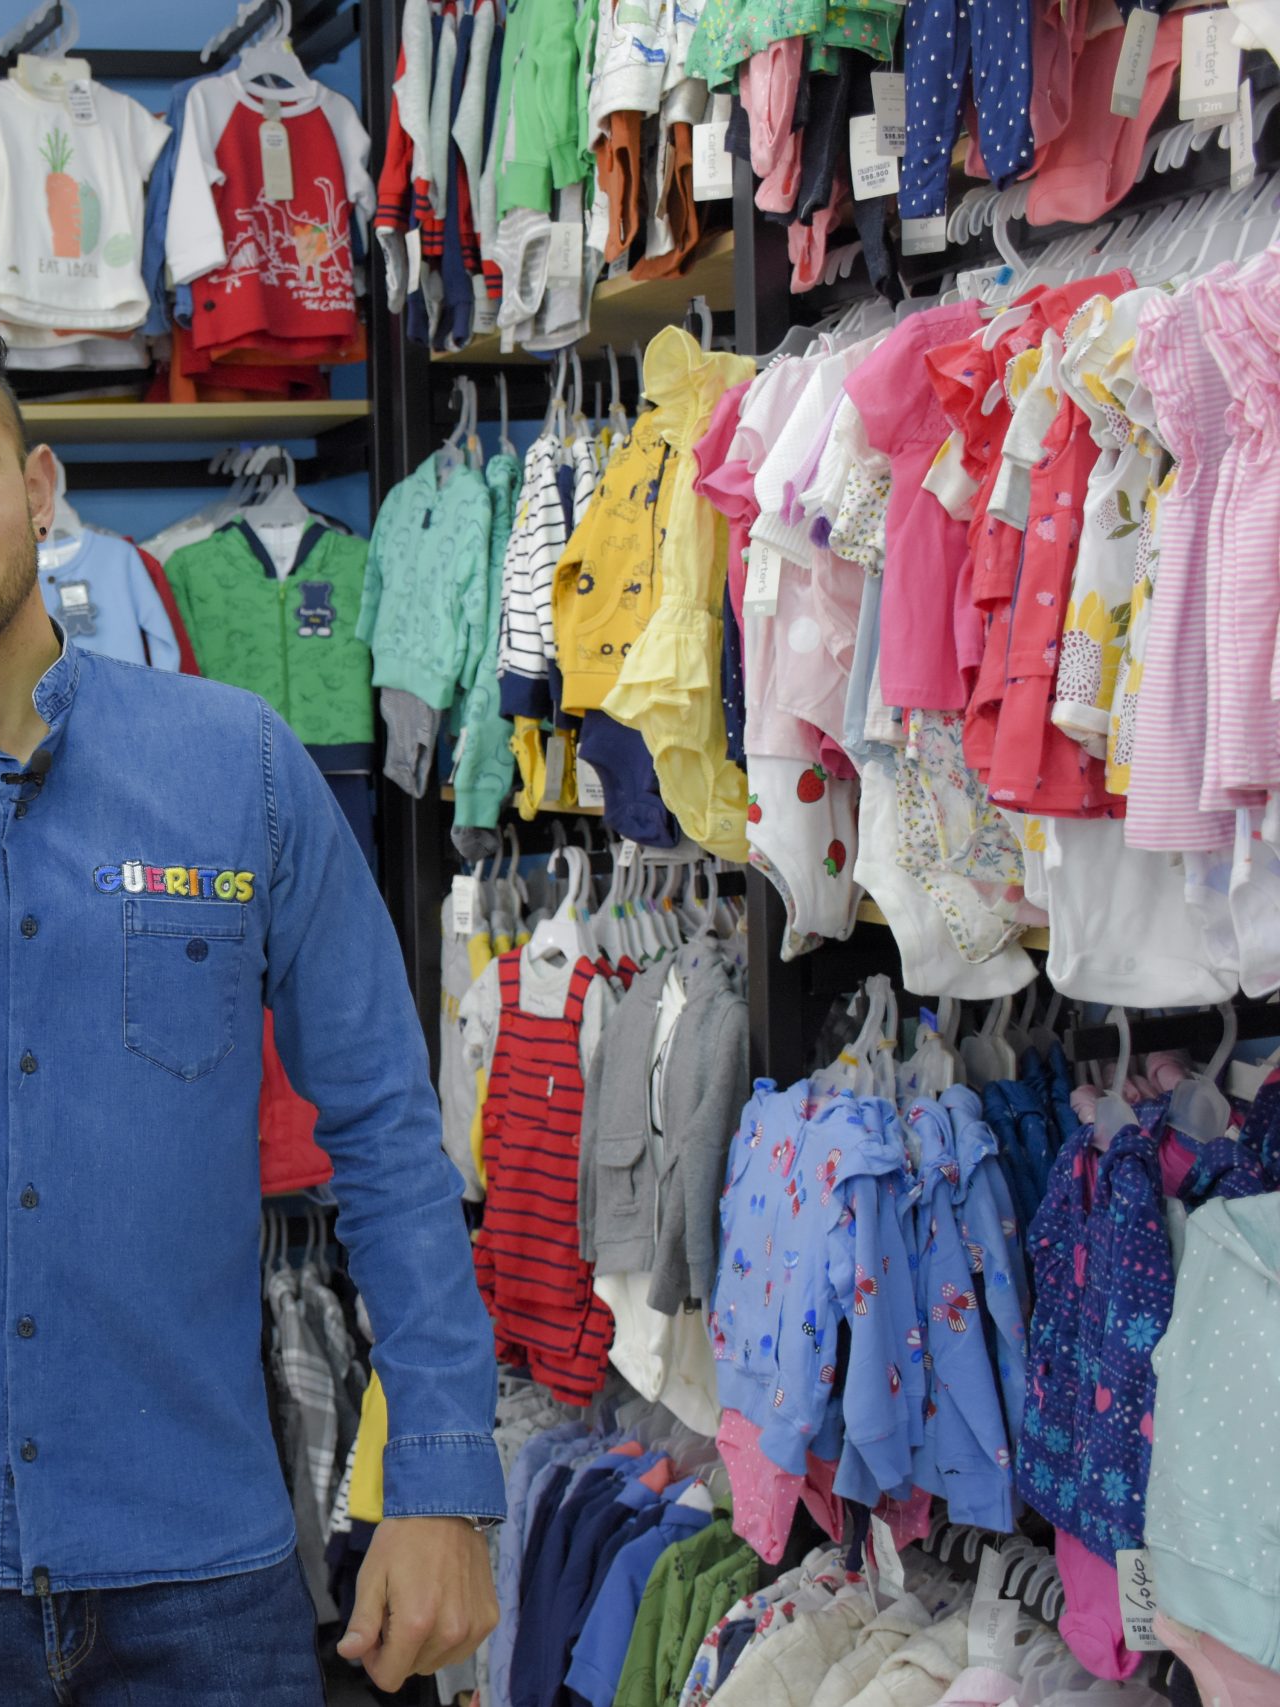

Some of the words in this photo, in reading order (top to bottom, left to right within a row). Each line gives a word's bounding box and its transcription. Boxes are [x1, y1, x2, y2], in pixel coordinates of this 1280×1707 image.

[1127, 25, 1146, 87] carter's
[1205, 25, 1219, 87] carter's
[1197, 102, 1222, 113] 12m
[38, 257, 60, 275] EAT
[758, 546, 769, 594] carter's
